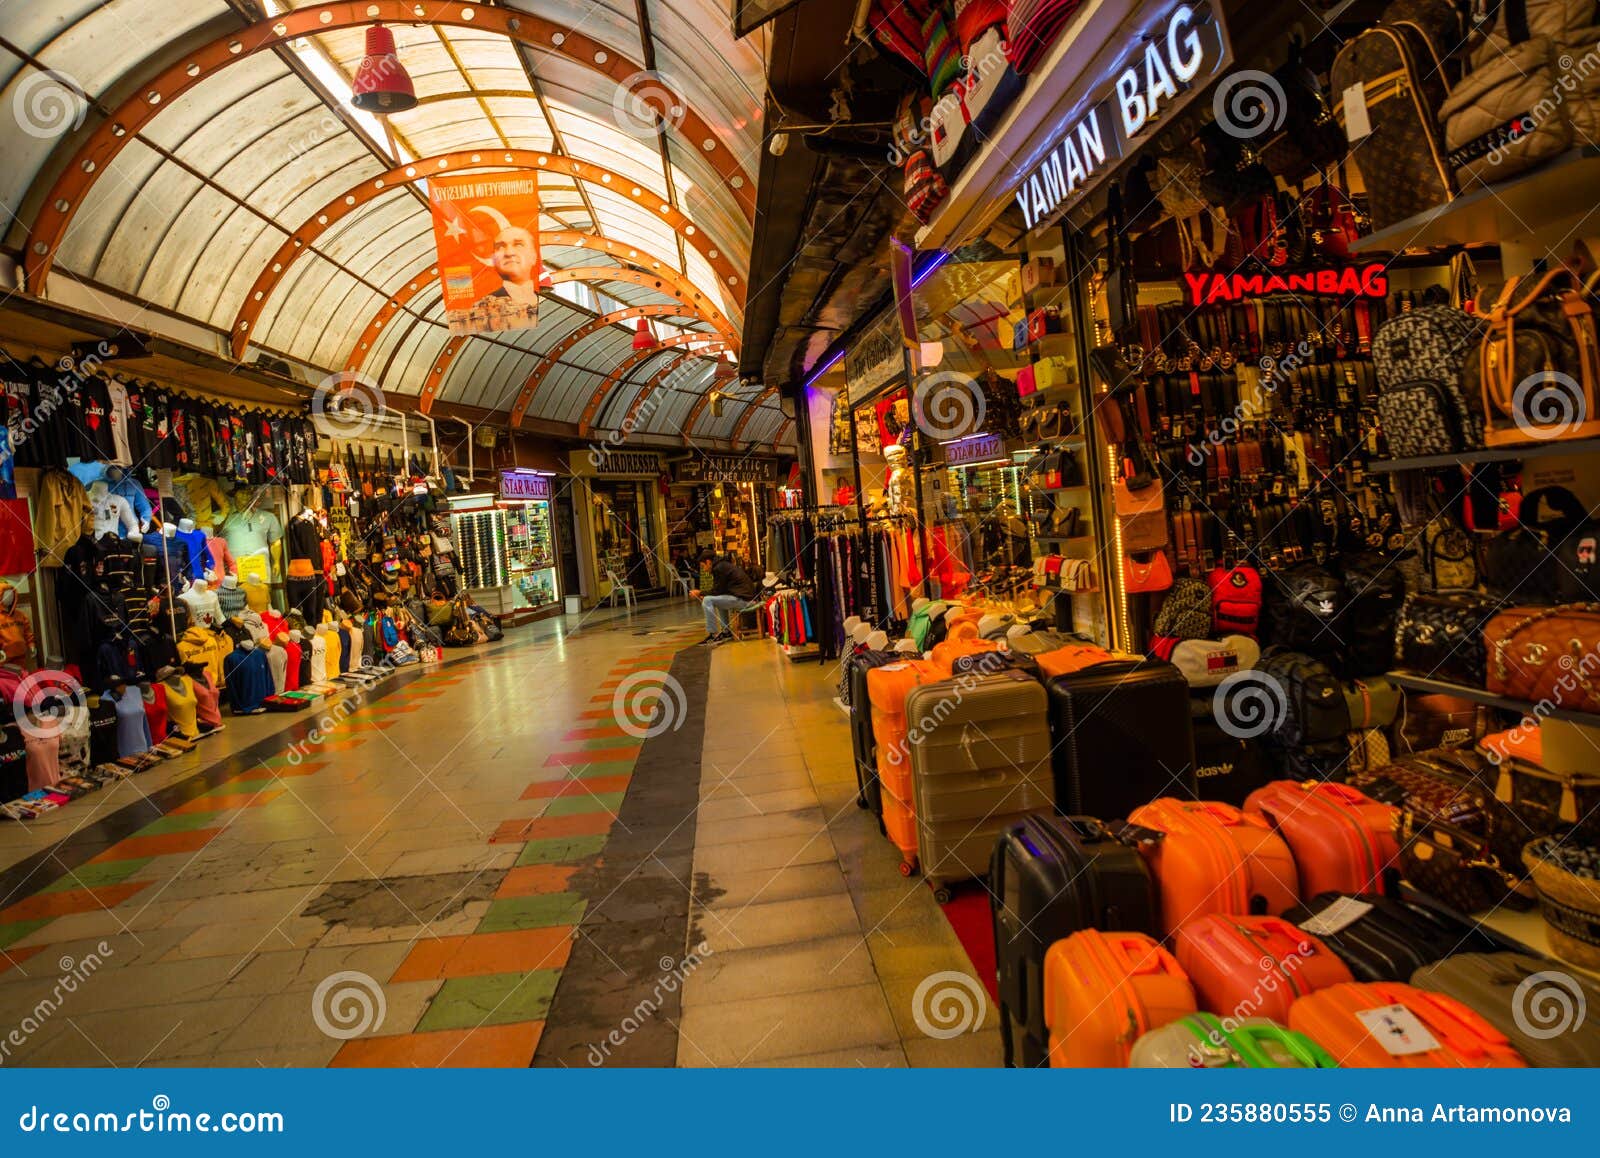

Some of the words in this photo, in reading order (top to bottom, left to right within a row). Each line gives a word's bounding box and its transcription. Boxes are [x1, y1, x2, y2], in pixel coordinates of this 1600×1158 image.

[1015, 109, 1106, 230] YAMAN
[1114, 3, 1204, 139] BAG
[1184, 264, 1387, 306] YAMANBAG
[597, 453, 660, 473] HAIRDRESSER
[701, 457, 761, 471] FANTASTIC
[504, 478, 524, 495] STAR
[524, 479, 548, 496] WATCH
